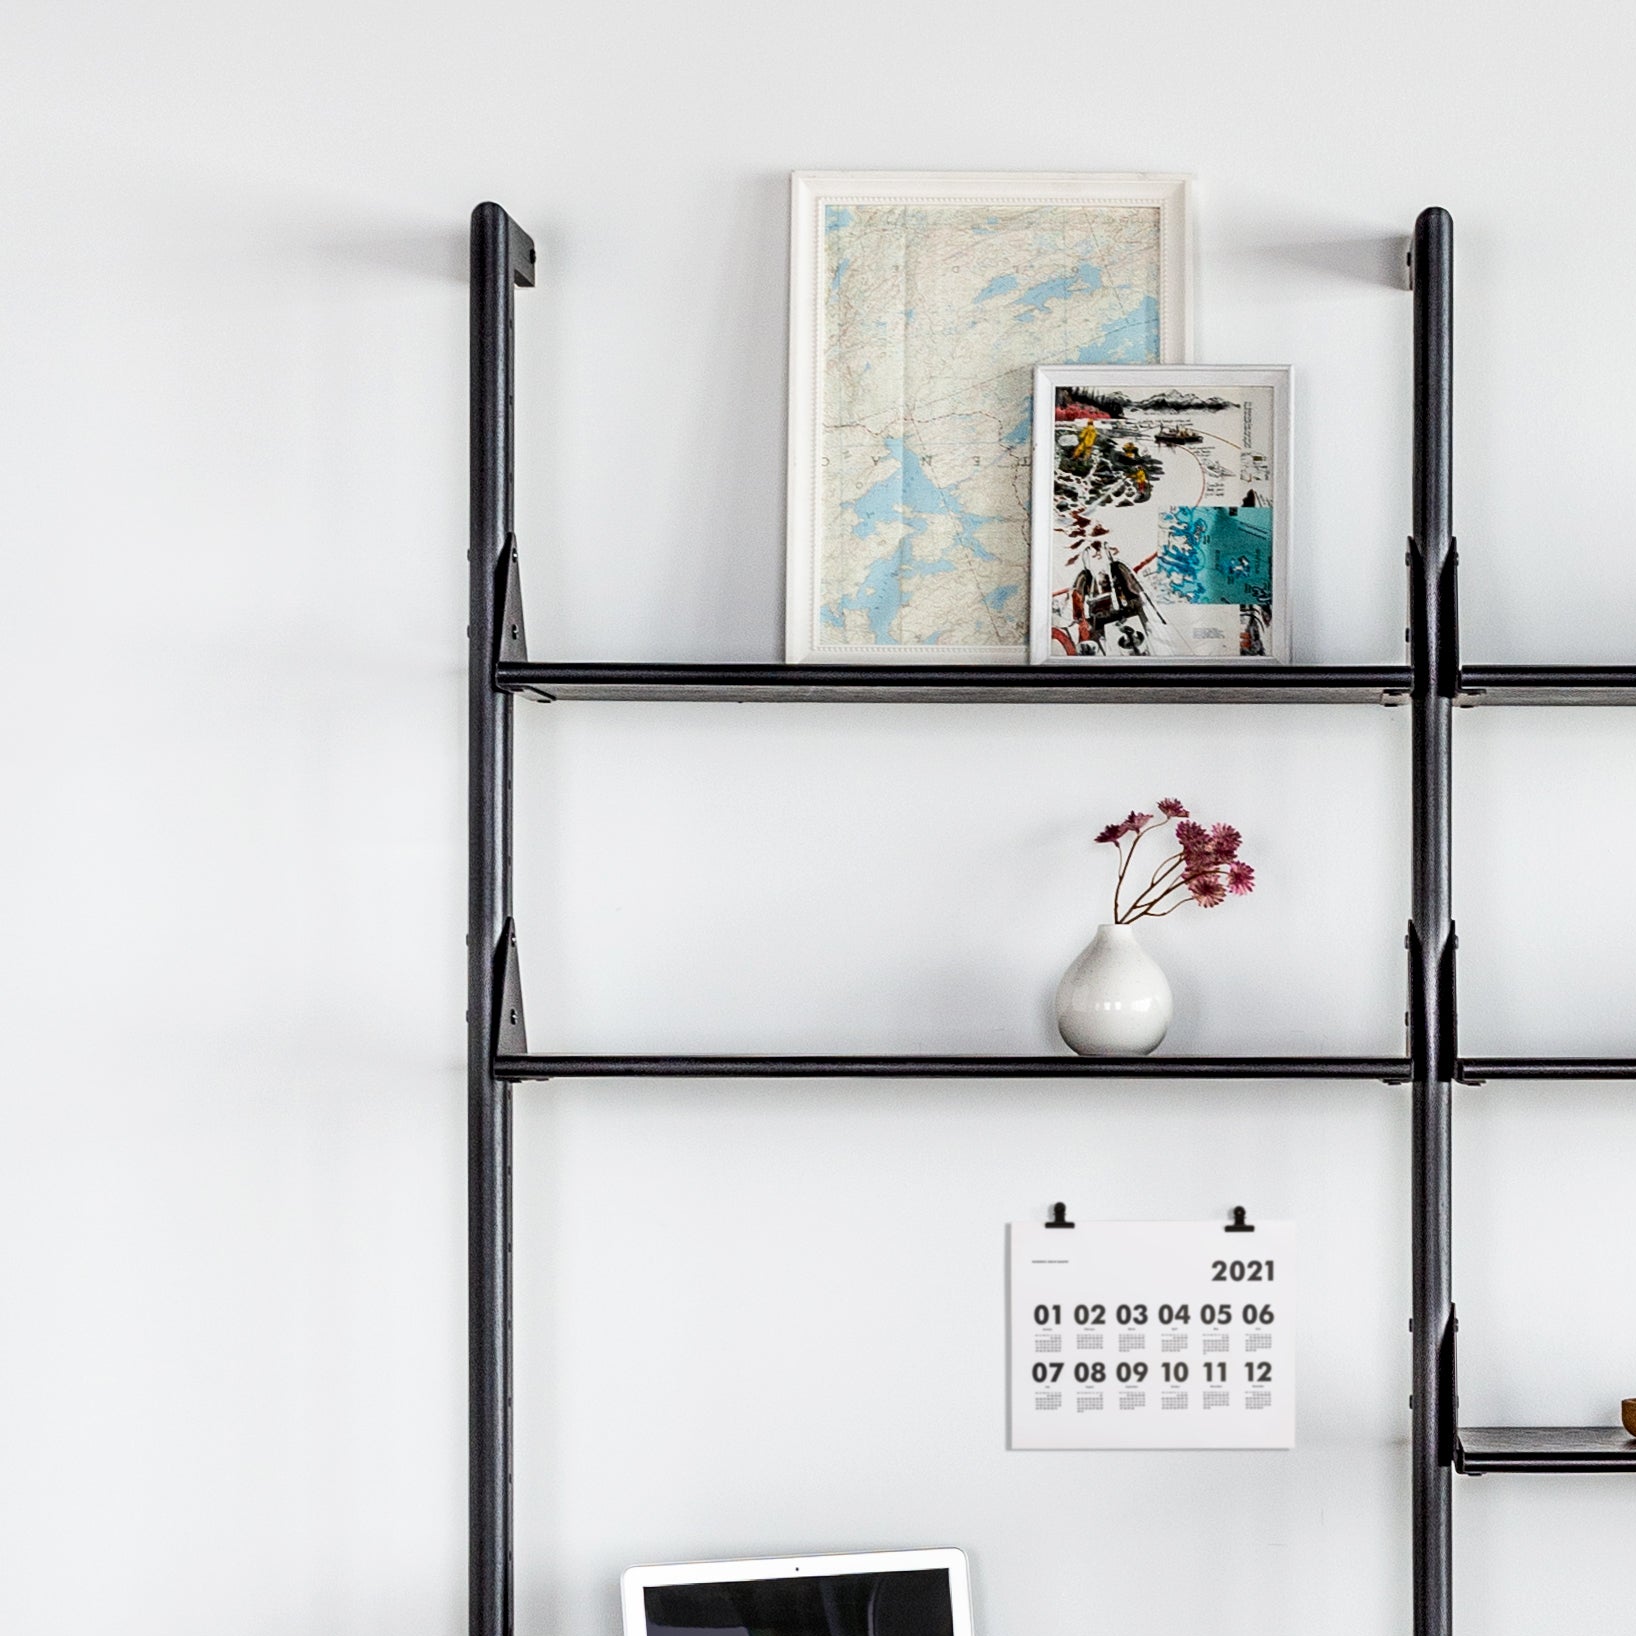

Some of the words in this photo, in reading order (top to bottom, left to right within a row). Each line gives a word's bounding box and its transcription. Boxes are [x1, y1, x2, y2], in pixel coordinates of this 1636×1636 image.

[1212, 1261, 1273, 1281] 2021
[1034, 1305, 1060, 1325] 01
[1074, 1305, 1105, 1325] 02
[1117, 1305, 1147, 1324] 03
[1159, 1305, 1190, 1324] 04
[1201, 1305, 1231, 1324] 05
[1243, 1304, 1274, 1324] 06
[1032, 1363, 1064, 1382] 07
[1075, 1363, 1105, 1382] 08
[1117, 1362, 1148, 1382] 09
[1162, 1362, 1188, 1382] 10
[1204, 1363, 1226, 1381] 11
[1245, 1362, 1271, 1381] 12
